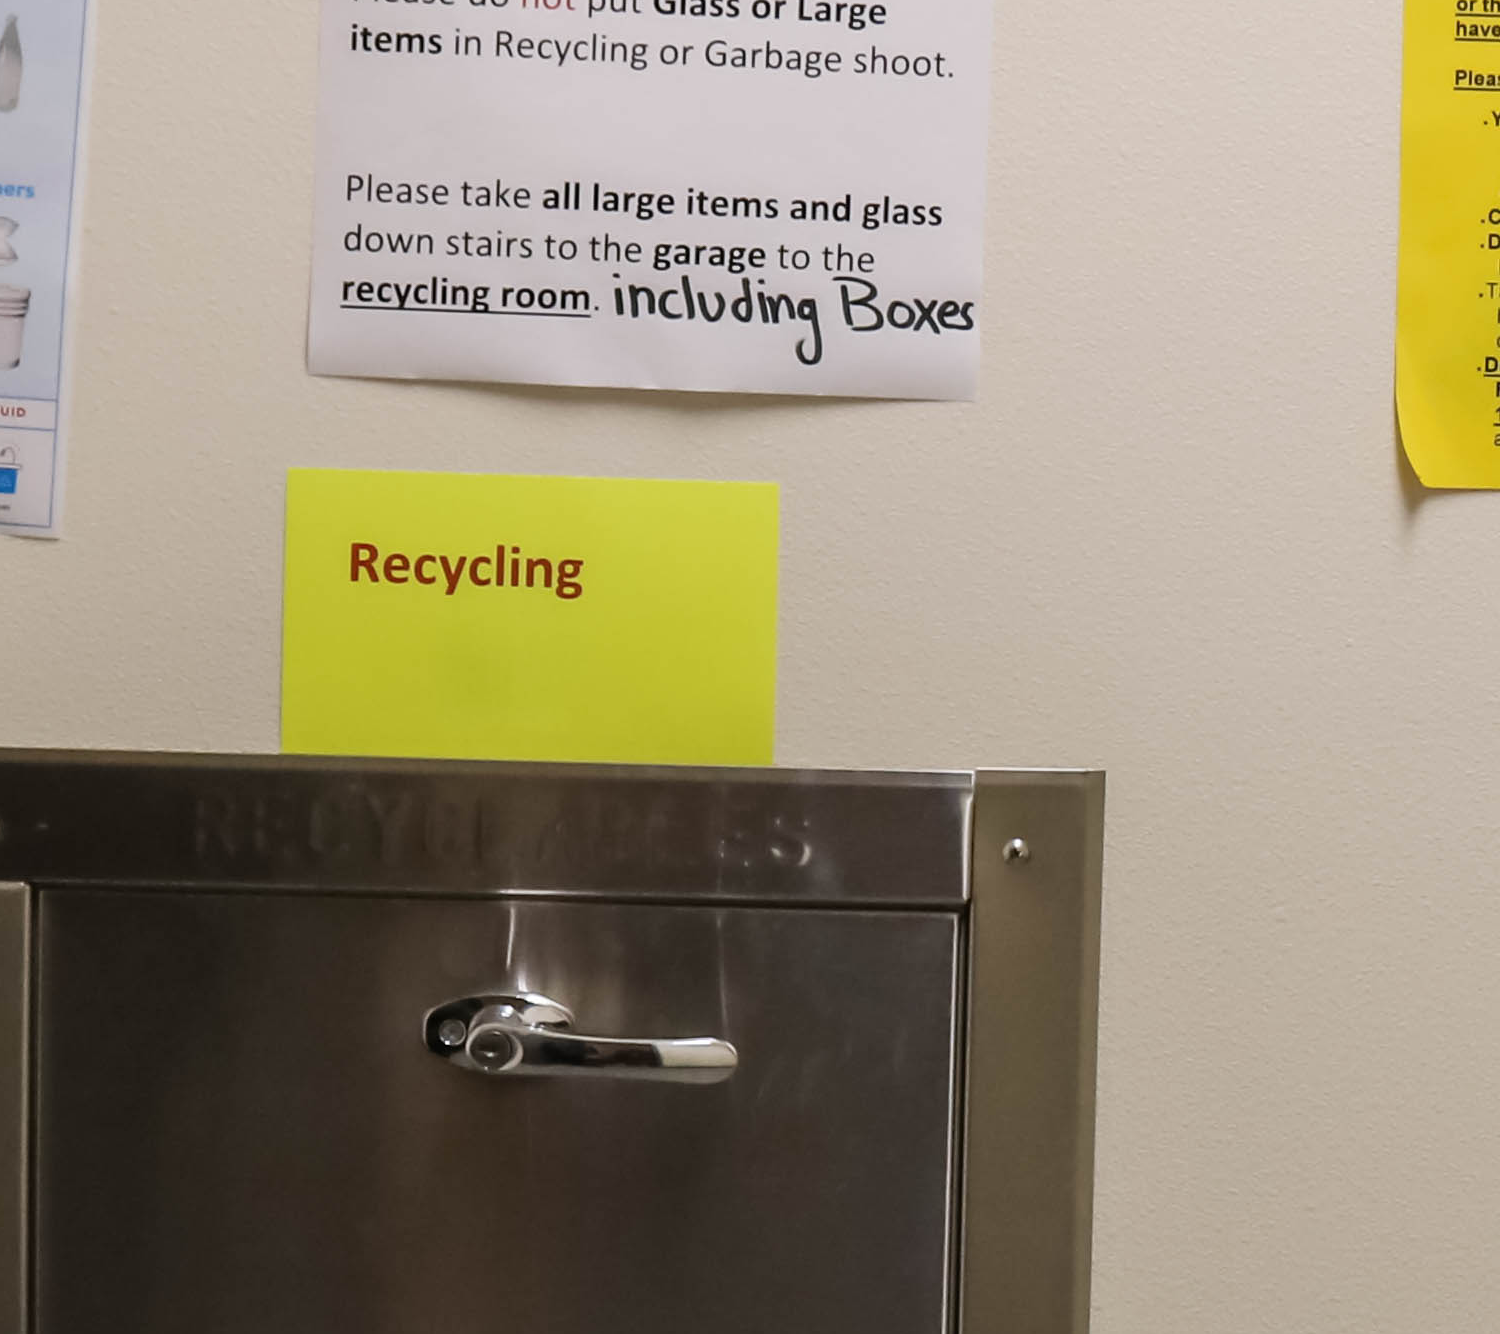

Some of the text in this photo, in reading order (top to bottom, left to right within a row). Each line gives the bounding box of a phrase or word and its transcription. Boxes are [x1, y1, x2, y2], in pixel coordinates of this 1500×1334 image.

[350, 22, 954, 79] items in Recycling or Garbage shoot.
[346, 172, 942, 230] Please take all large items and glass
[343, 222, 875, 274] down stairs to the garage to the
[340, 276, 599, 312] recycling room.
[611, 271, 975, 366] including Boxes
[349, 541, 584, 600] Recycling
